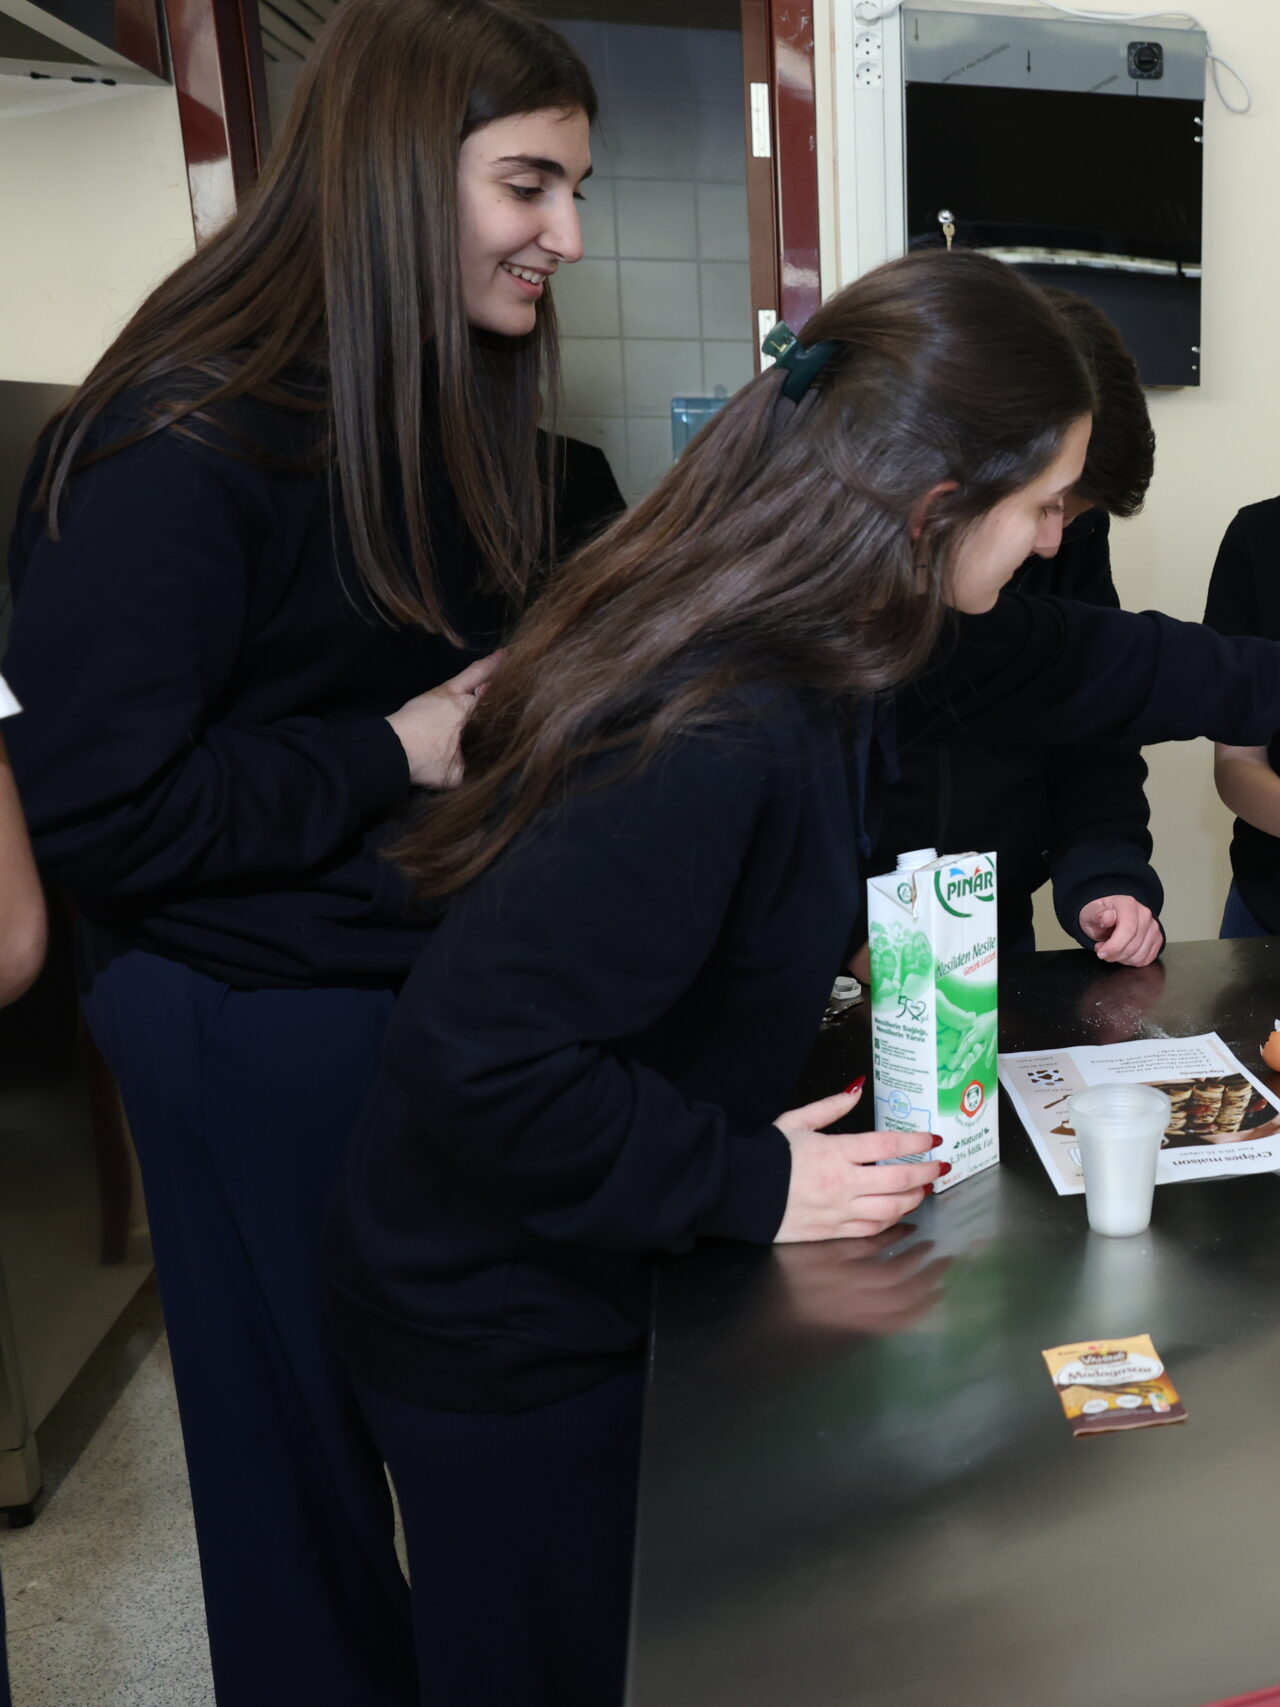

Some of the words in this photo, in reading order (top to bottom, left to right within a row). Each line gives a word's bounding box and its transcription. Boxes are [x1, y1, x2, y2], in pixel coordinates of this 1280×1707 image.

[946, 871, 994, 901] PINAR
[936, 950, 971, 980] Nesilden
[972, 936, 996, 960] Nesile
[961, 1129, 984, 1147] Natural
[1172, 1158, 1223, 1166] maison
